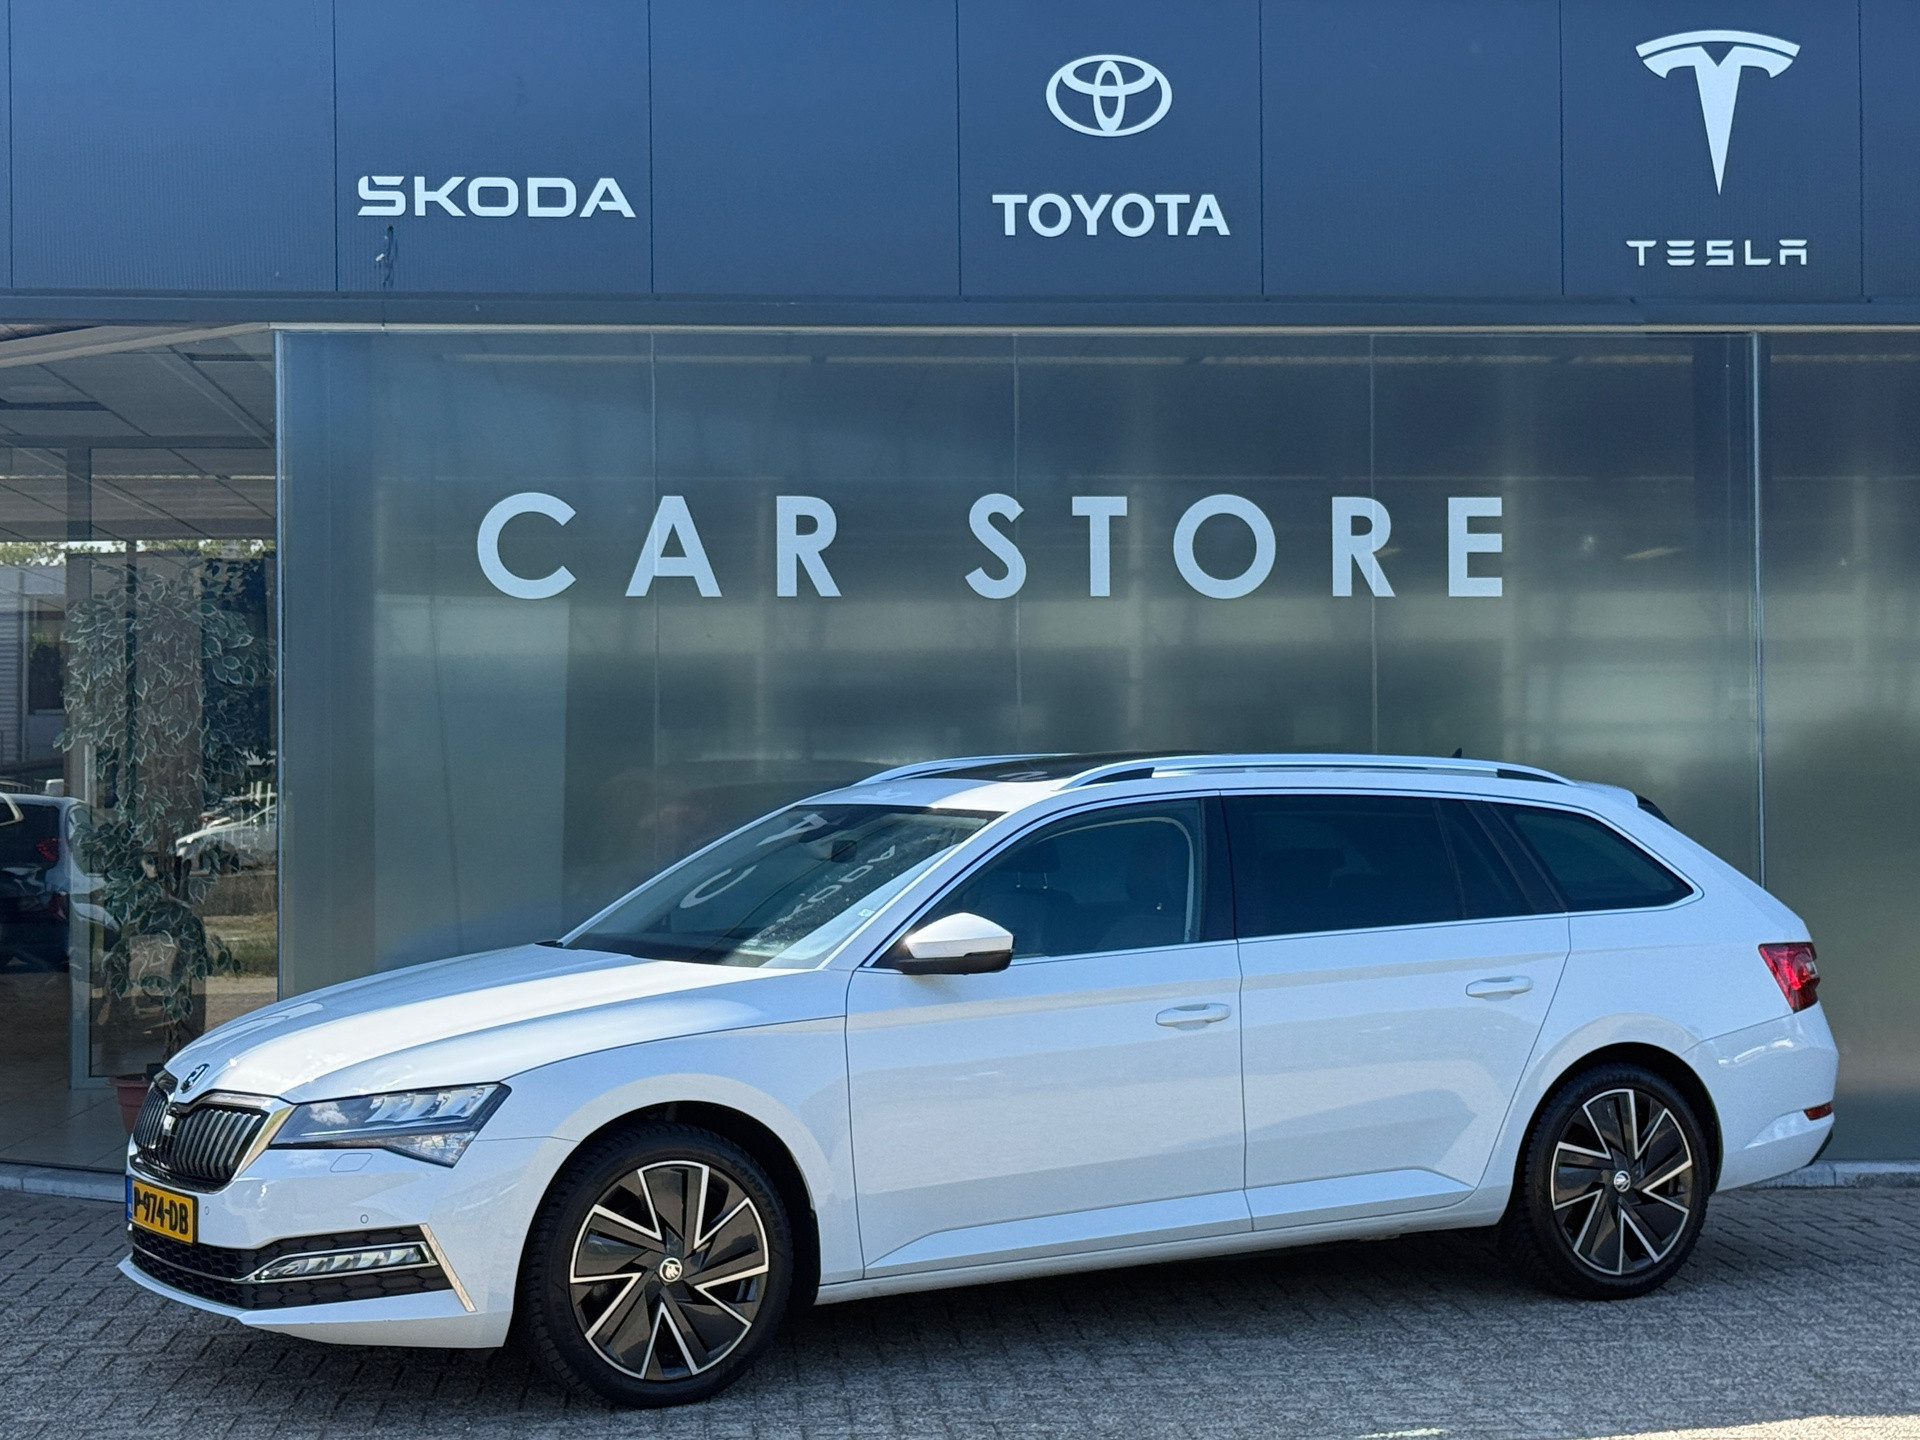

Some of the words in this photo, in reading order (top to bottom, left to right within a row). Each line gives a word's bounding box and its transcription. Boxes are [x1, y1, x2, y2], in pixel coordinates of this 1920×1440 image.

[357, 175, 636, 218] SKODA
[991, 193, 1231, 237] TOYOTA
[1625, 239, 1807, 266] TESLA
[476, 491, 842, 600] CAR
[964, 493, 1503, 600] STORE
[133, 1186, 189, 1236] P-974-DB
